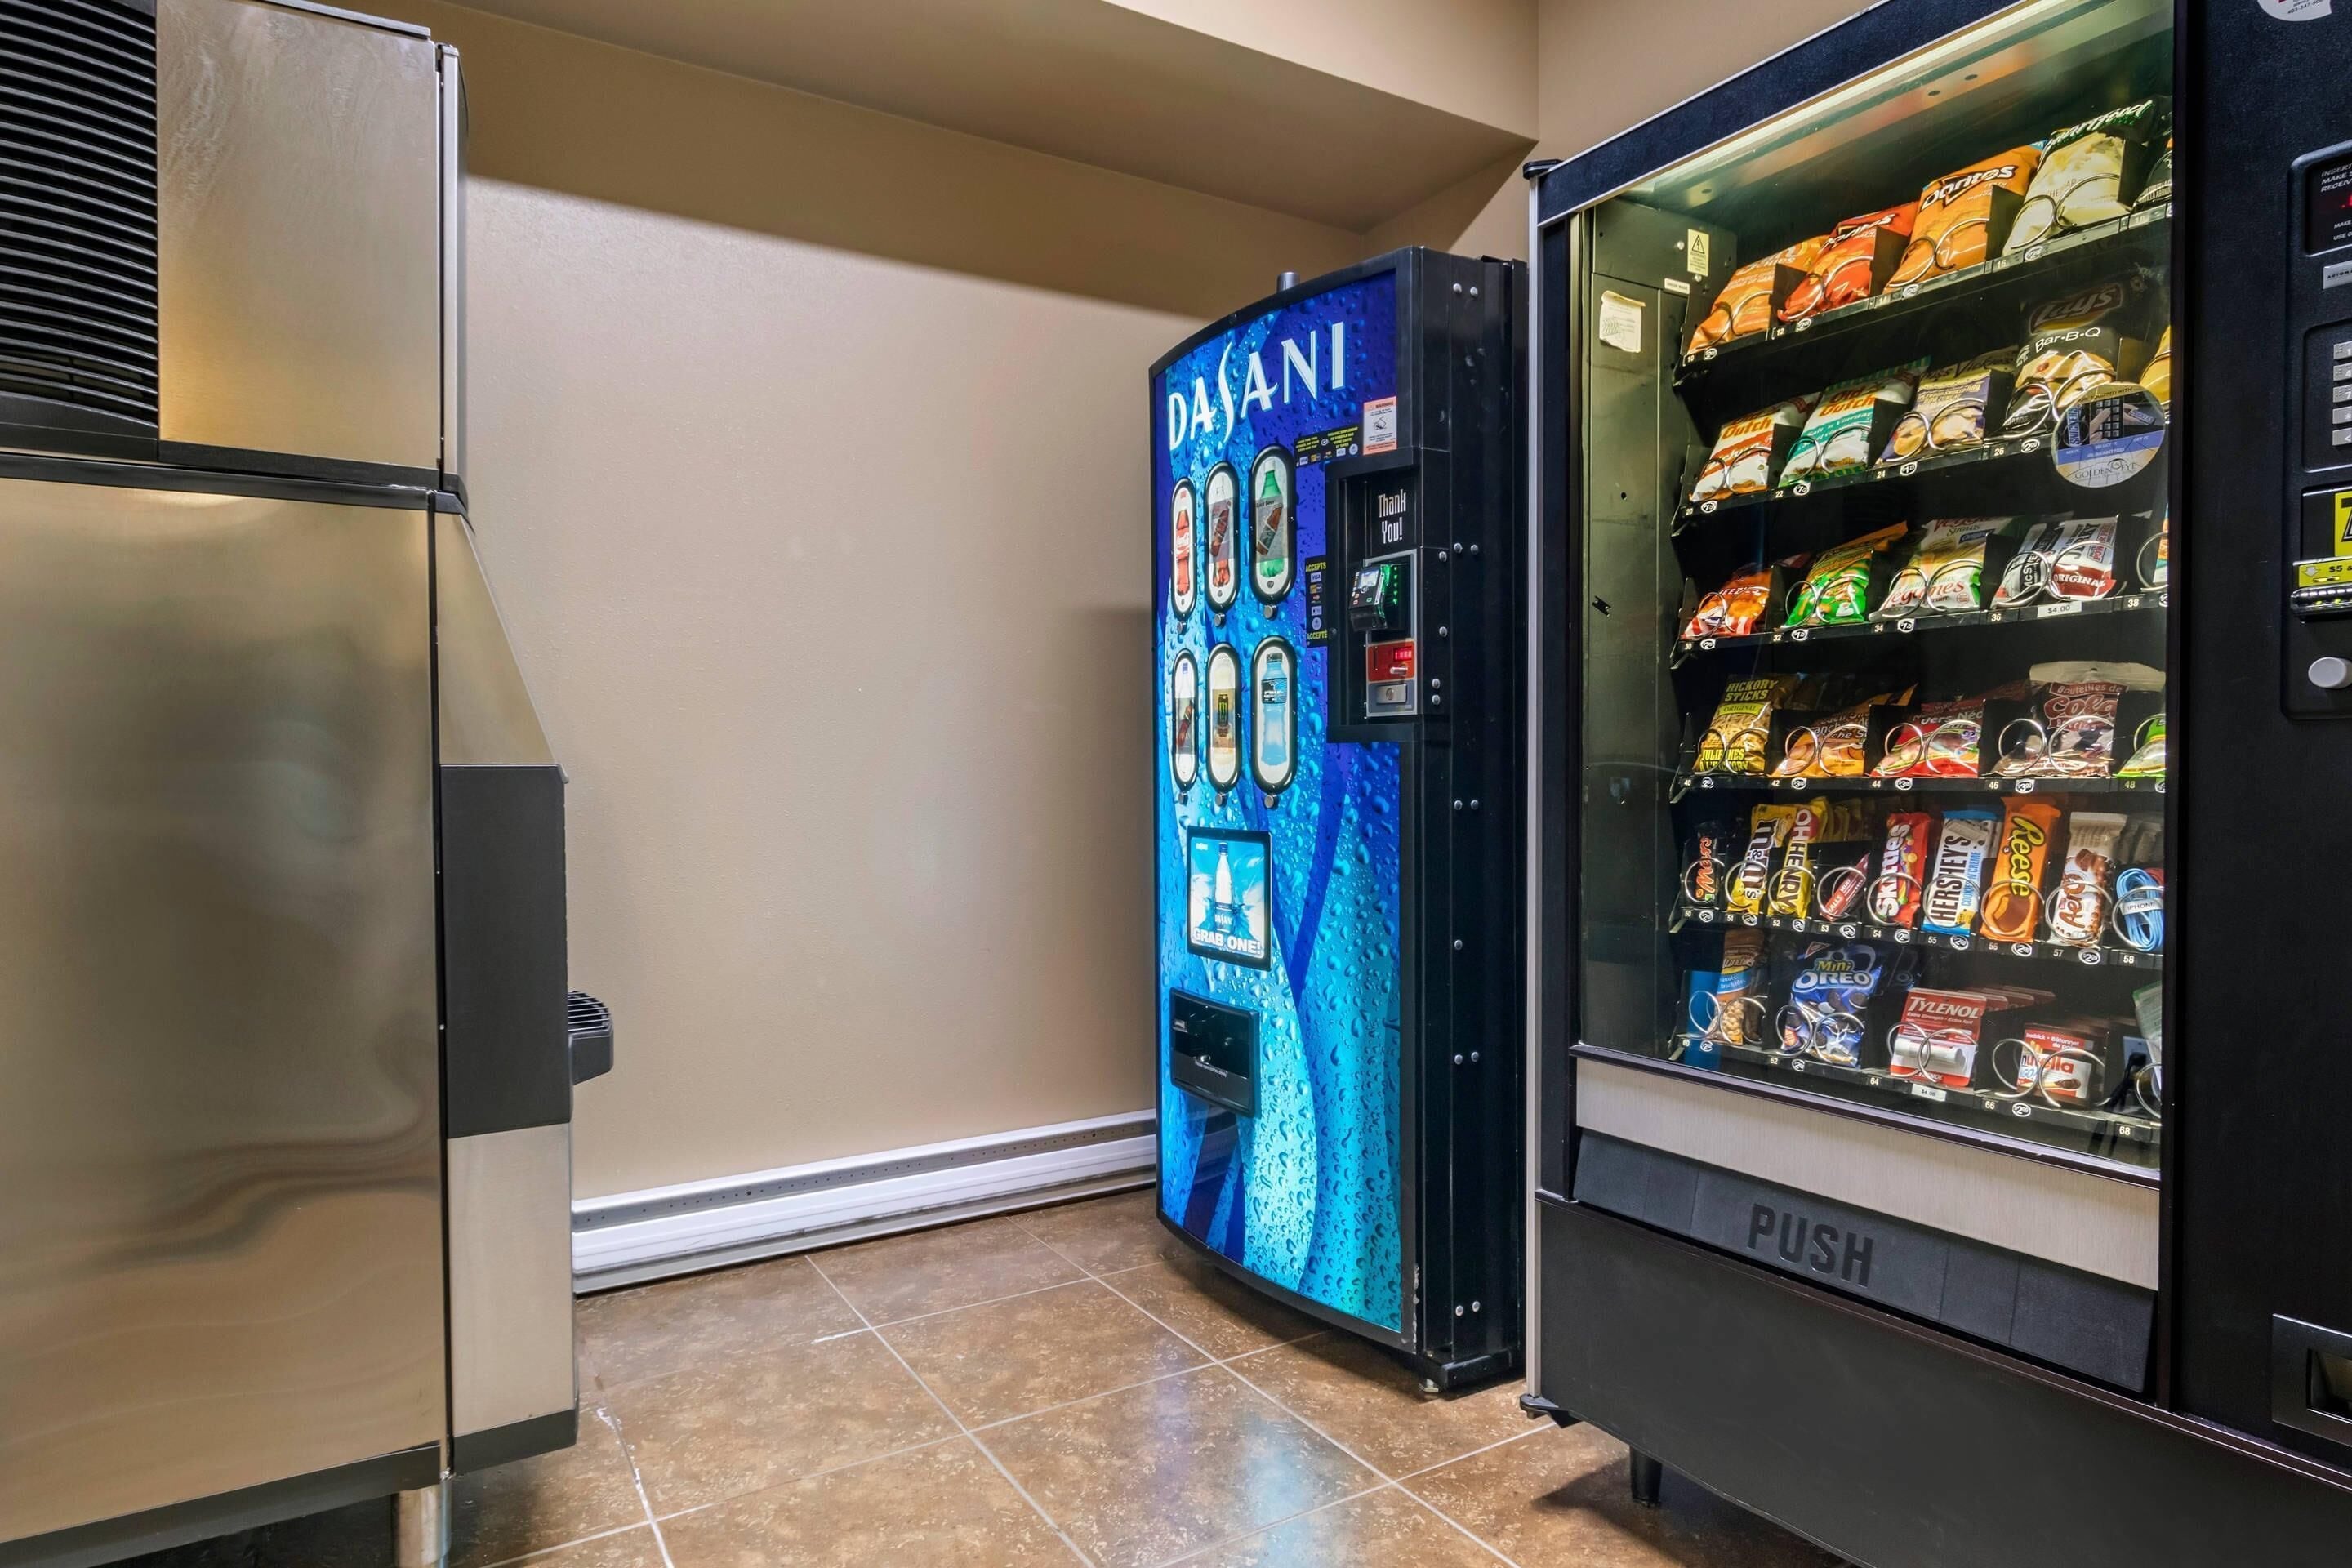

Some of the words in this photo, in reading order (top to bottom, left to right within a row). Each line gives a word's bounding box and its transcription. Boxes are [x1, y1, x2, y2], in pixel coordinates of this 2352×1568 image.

[1921, 166, 2017, 211] Doritos
[1997, 259, 2007, 268] 16
[1776, 328, 1784, 336] 12
[2035, 327, 2101, 353] Bar-B-Q
[1169, 322, 1345, 451] DASANI
[1819, 394, 1876, 417] Dutch
[1722, 417, 1775, 440] Dutch
[1993, 447, 2005, 457] 26
[1877, 470, 1886, 479] 24
[1378, 489, 1407, 518] Thank
[1381, 517, 1403, 544] You!
[1306, 561, 1327, 572] ACCEPTS
[2329, 565, 2343, 573] $5
[2053, 574, 2106, 587] ORIGINAL
[2127, 599, 2140, 608] 38
[1991, 613, 2002, 621] 36
[1874, 624, 1883, 633] 34
[1773, 634, 1782, 642] 32
[1726, 679, 1778, 693] HICKORY
[1724, 689, 1769, 702] STICKS
[2043, 693, 2118, 719] Cola
[1702, 748, 1745, 760] JULIENES
[1872, 780, 1881, 788] 44
[1988, 781, 1999, 790] 46
[2124, 781, 2136, 789] 48
[1794, 808, 1812, 839] OH
[1931, 835, 1971, 922] HERSHEY'S
[1772, 919, 1780, 927] 52
[1820, 924, 1829, 933] 53
[1873, 930, 1882, 938] 54
[1194, 927, 1224, 947] GRAB
[1227, 935, 1262, 956] ONE!
[1928, 936, 1937, 944] 55
[1989, 942, 1998, 951] 56
[2053, 949, 2064, 957] 57
[2123, 955, 2135, 964] 58
[1816, 960, 1852, 972] Mini
[1795, 971, 1870, 989] OREO
[1907, 996, 1981, 1019] TYLENOL
[2020, 1054, 2074, 1075] nuella
[1870, 1077, 1879, 1085] 64
[1984, 1100, 1995, 1110] 66
[2119, 1126, 2131, 1135] 68
[1747, 1203, 1874, 1289] PUSH
